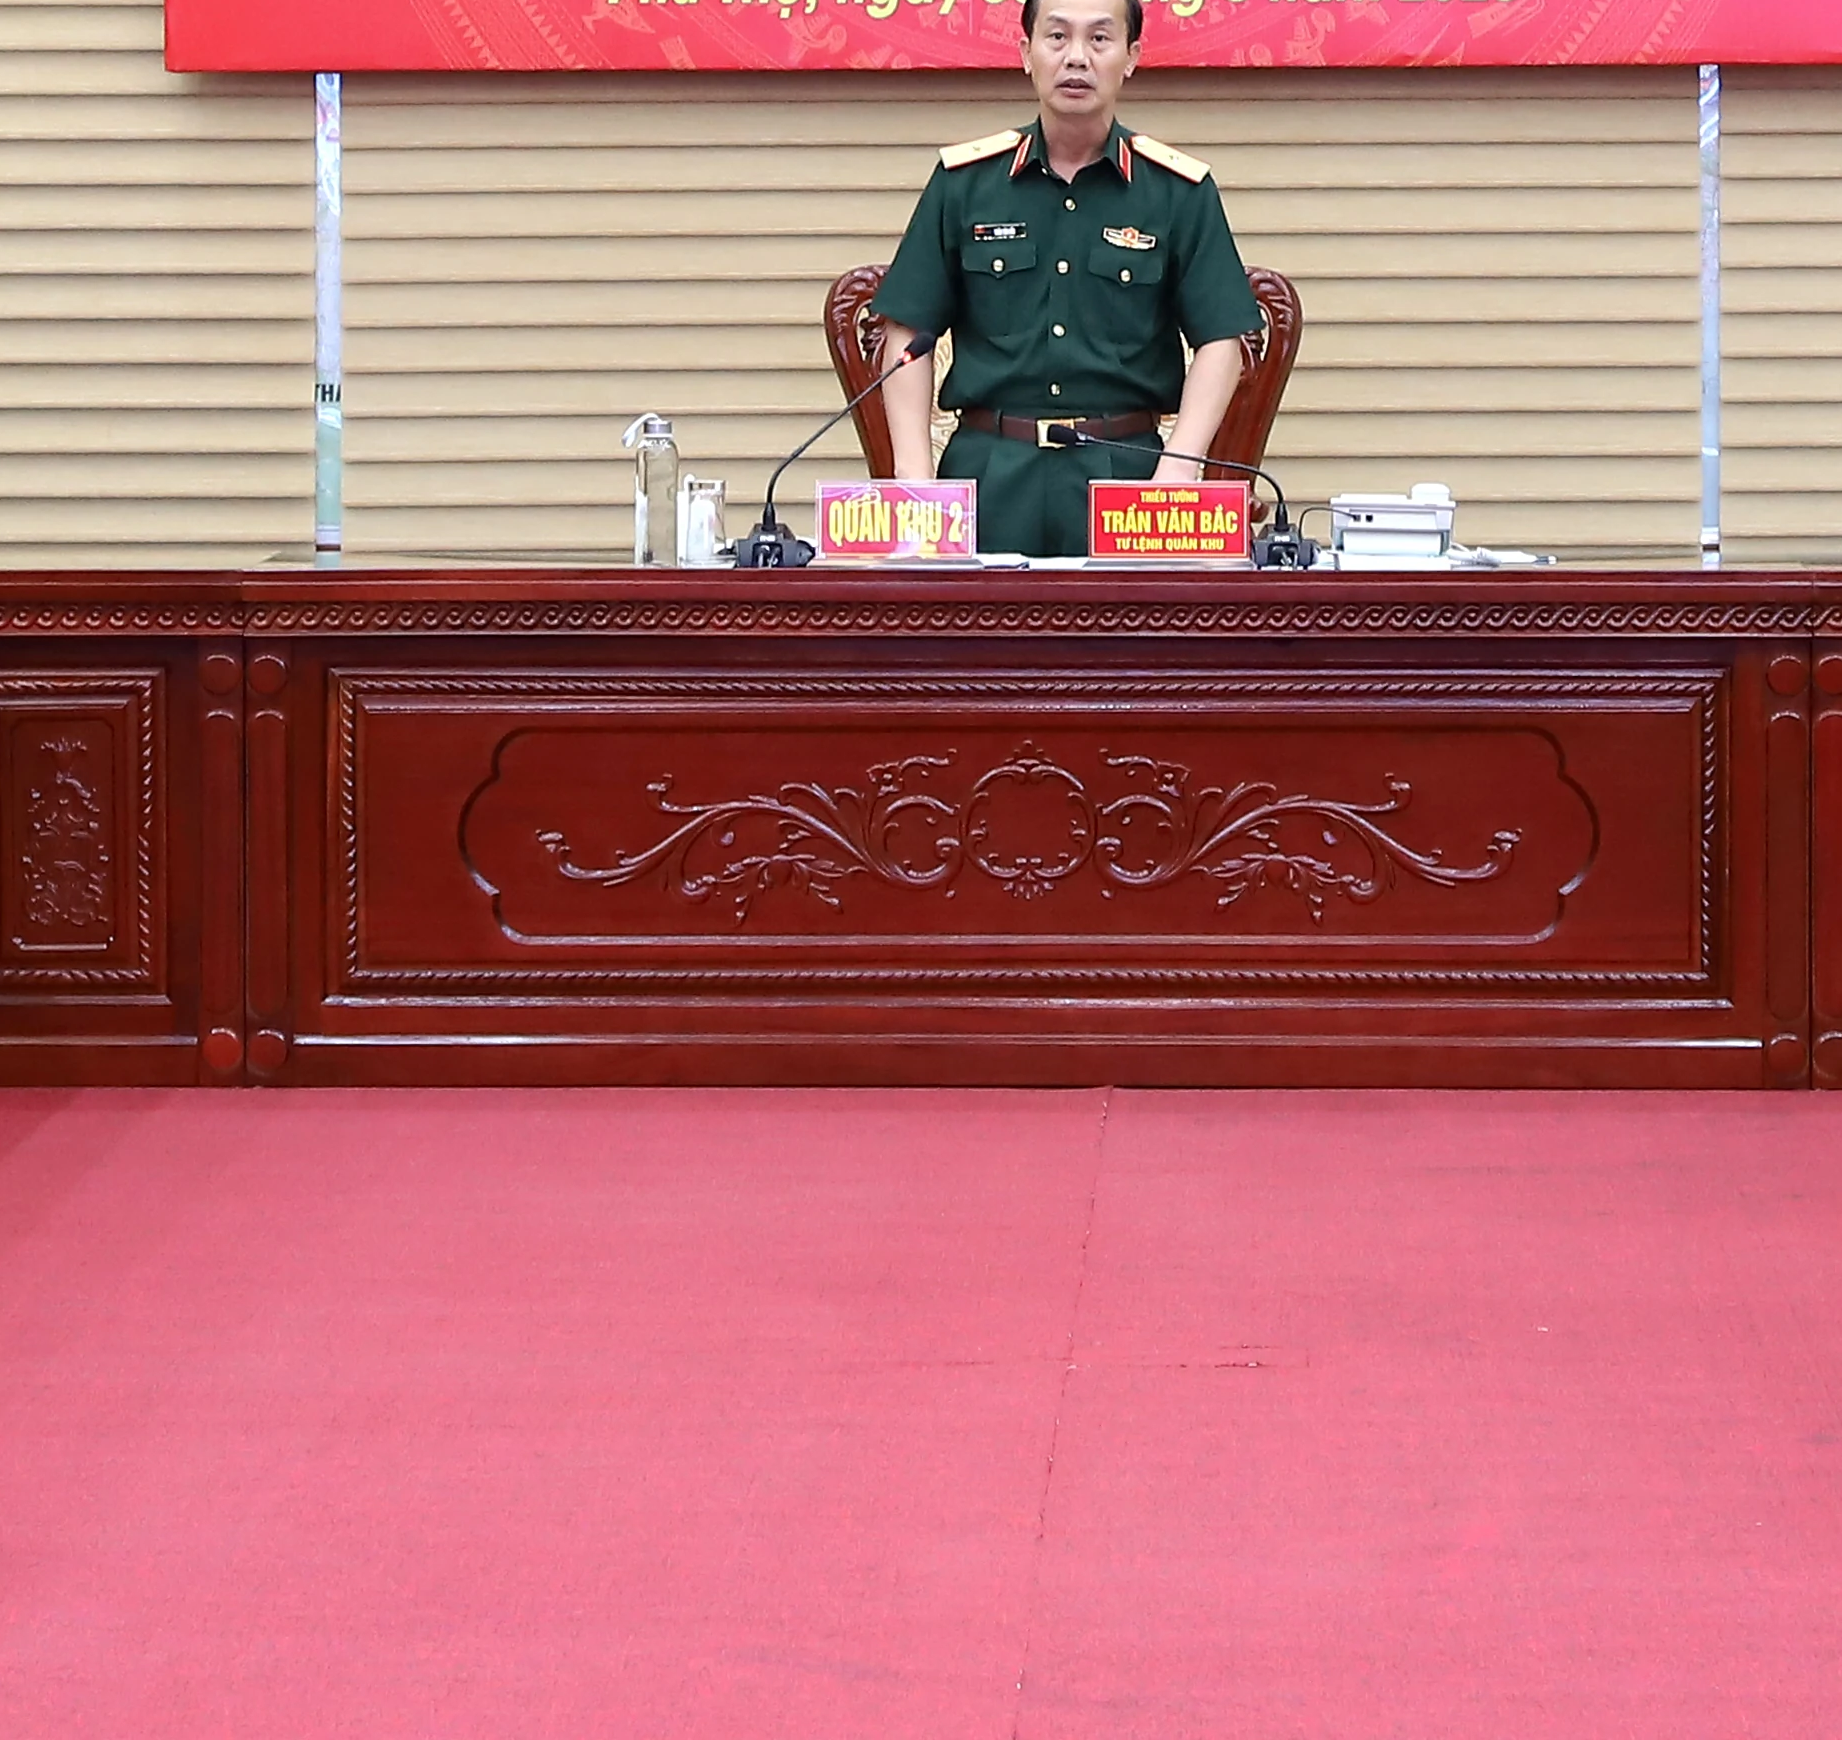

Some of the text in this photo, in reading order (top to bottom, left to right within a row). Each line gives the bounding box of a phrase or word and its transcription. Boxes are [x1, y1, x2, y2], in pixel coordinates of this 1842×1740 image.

[828, 495, 964, 548] QUÂN KHU 2
[1100, 502, 1239, 535] TRẦN VĂN BẮC
[1114, 536, 1226, 553] TƯ LỆNH QUÂN KHU
